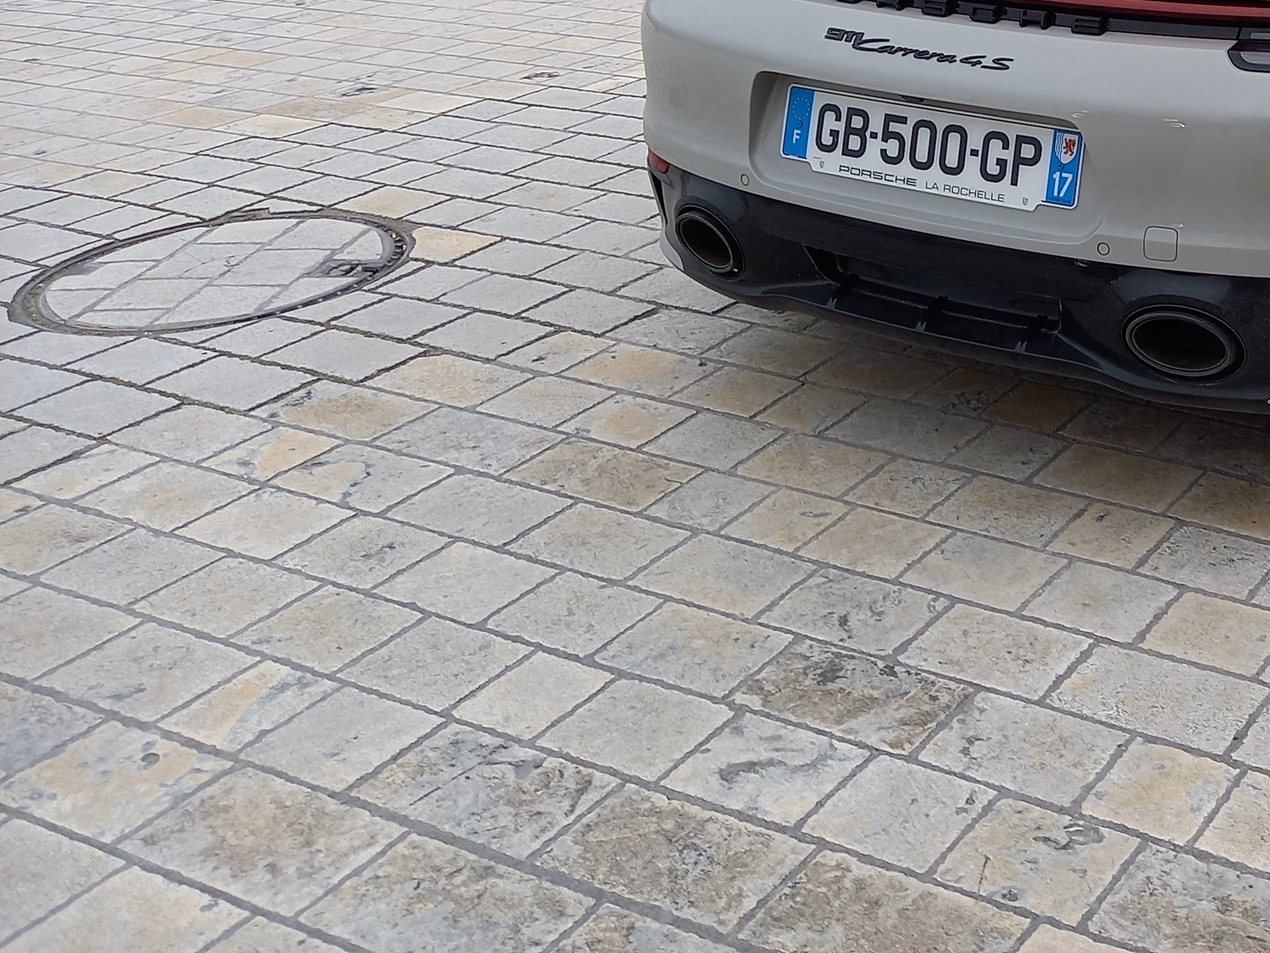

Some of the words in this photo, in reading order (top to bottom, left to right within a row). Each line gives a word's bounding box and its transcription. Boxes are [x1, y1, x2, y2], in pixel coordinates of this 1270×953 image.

[792, 128, 802, 144] F
[815, 102, 1043, 187] GB-500-GP
[838, 164, 917, 187] PORSCHE
[924, 180, 939, 192] LA
[943, 184, 1005, 203] ROCHELLE
[1051, 169, 1074, 198] 17
